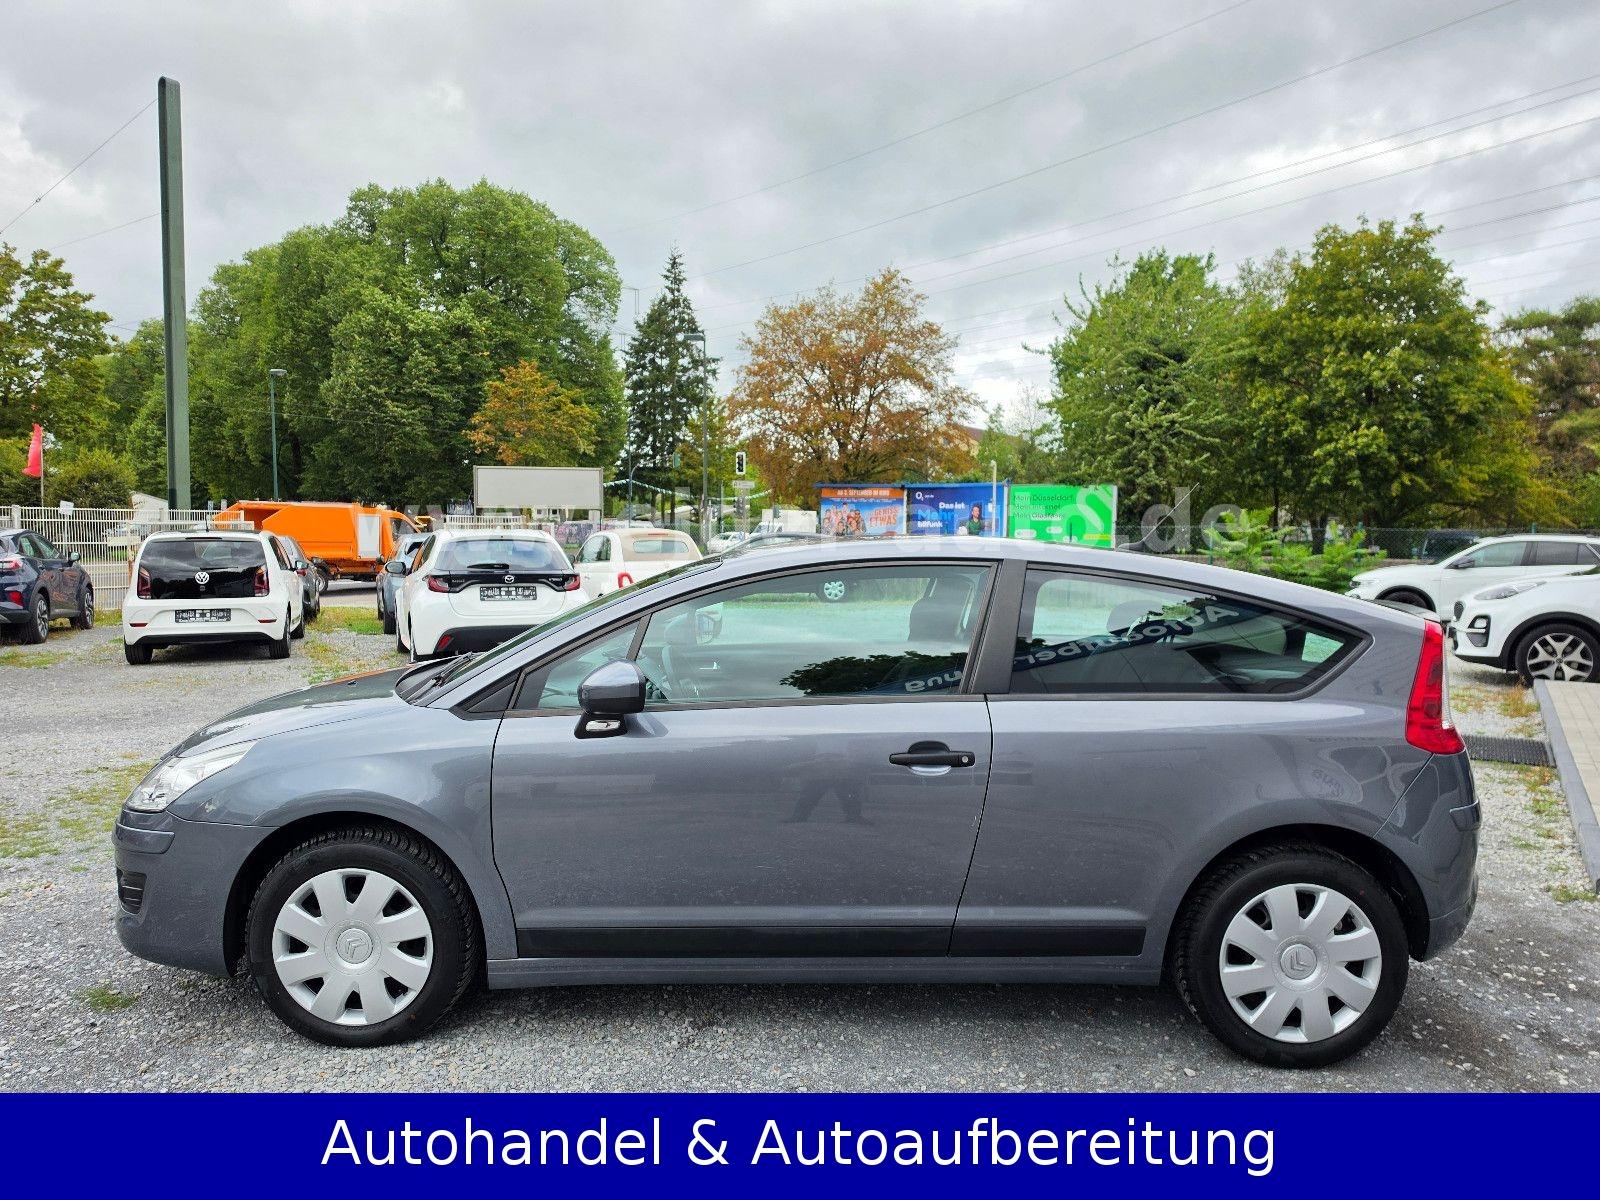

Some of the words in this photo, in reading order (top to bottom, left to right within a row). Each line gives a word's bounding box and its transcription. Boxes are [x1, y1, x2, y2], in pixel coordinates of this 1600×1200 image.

[939, 501, 954, 509] Das
[955, 501, 966, 509] ist
[918, 510, 954, 520] Mehr
